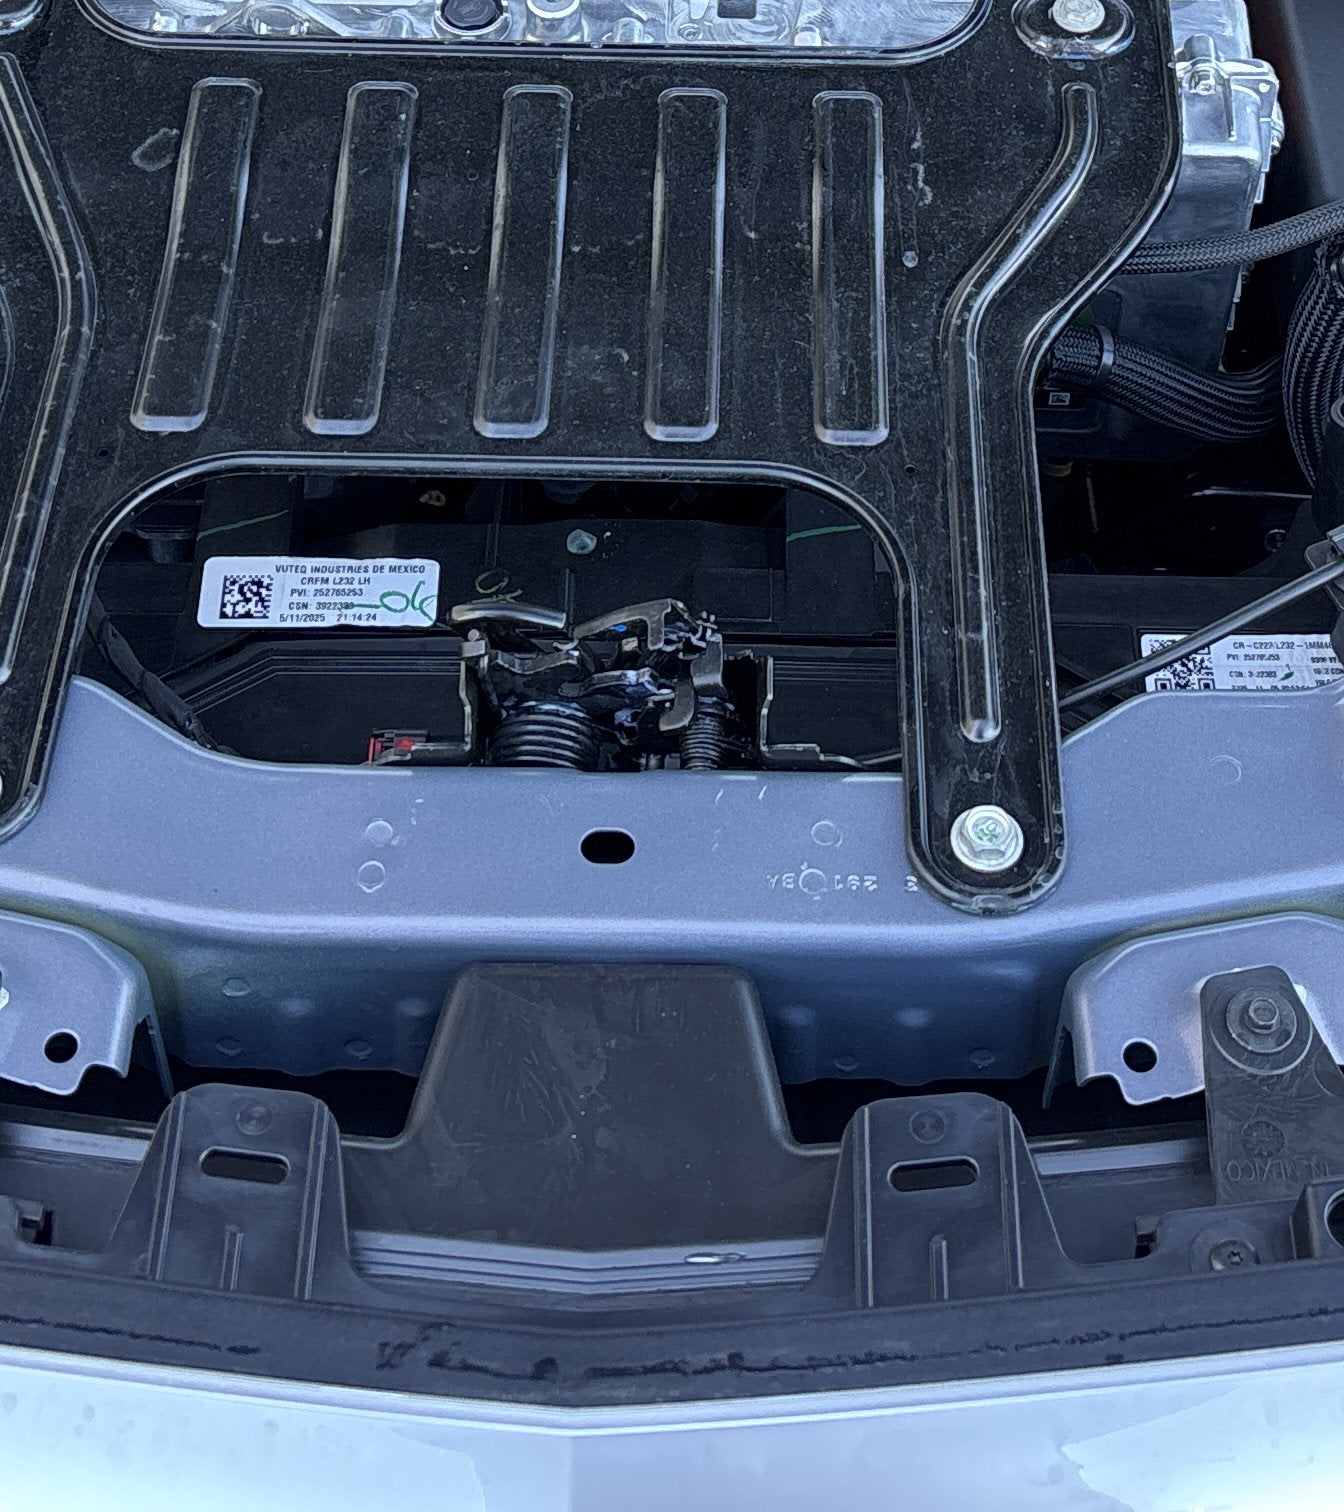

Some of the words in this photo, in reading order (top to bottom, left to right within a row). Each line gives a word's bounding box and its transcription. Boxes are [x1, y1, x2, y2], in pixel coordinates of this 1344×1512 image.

[275, 564, 308, 574] VUTEQ
[310, 564, 367, 574] INDUSTRIES
[372, 564, 385, 574] DE
[388, 564, 426, 574] MEXICO
[300, 577, 330, 586] CRFM
[332, 577, 355, 586] L232
[358, 577, 371, 586] LH
